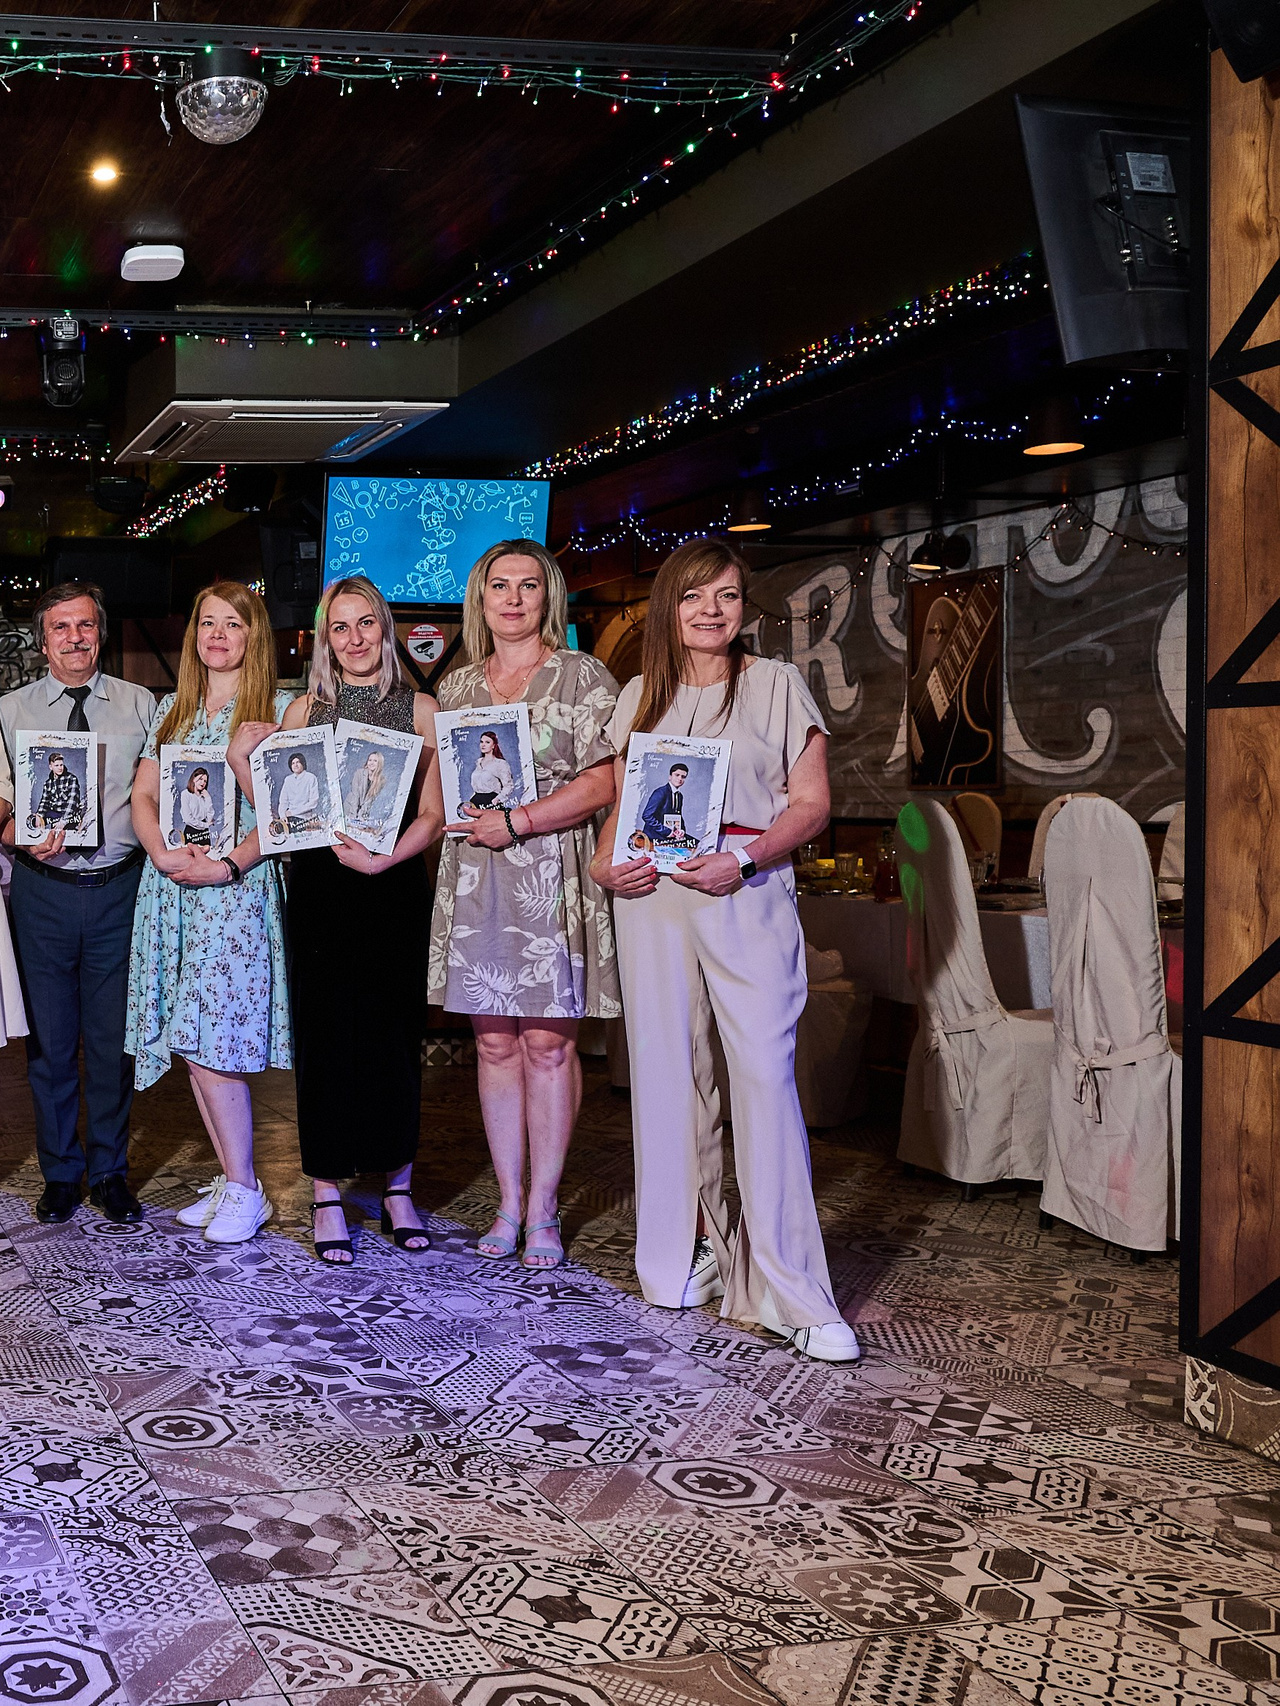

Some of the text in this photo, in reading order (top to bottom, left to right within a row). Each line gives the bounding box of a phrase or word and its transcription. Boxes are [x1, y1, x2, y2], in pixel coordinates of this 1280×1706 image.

[339, 517, 350, 526] 15
[211, 751, 225, 760] 202
[699, 745, 721, 757] 2024
